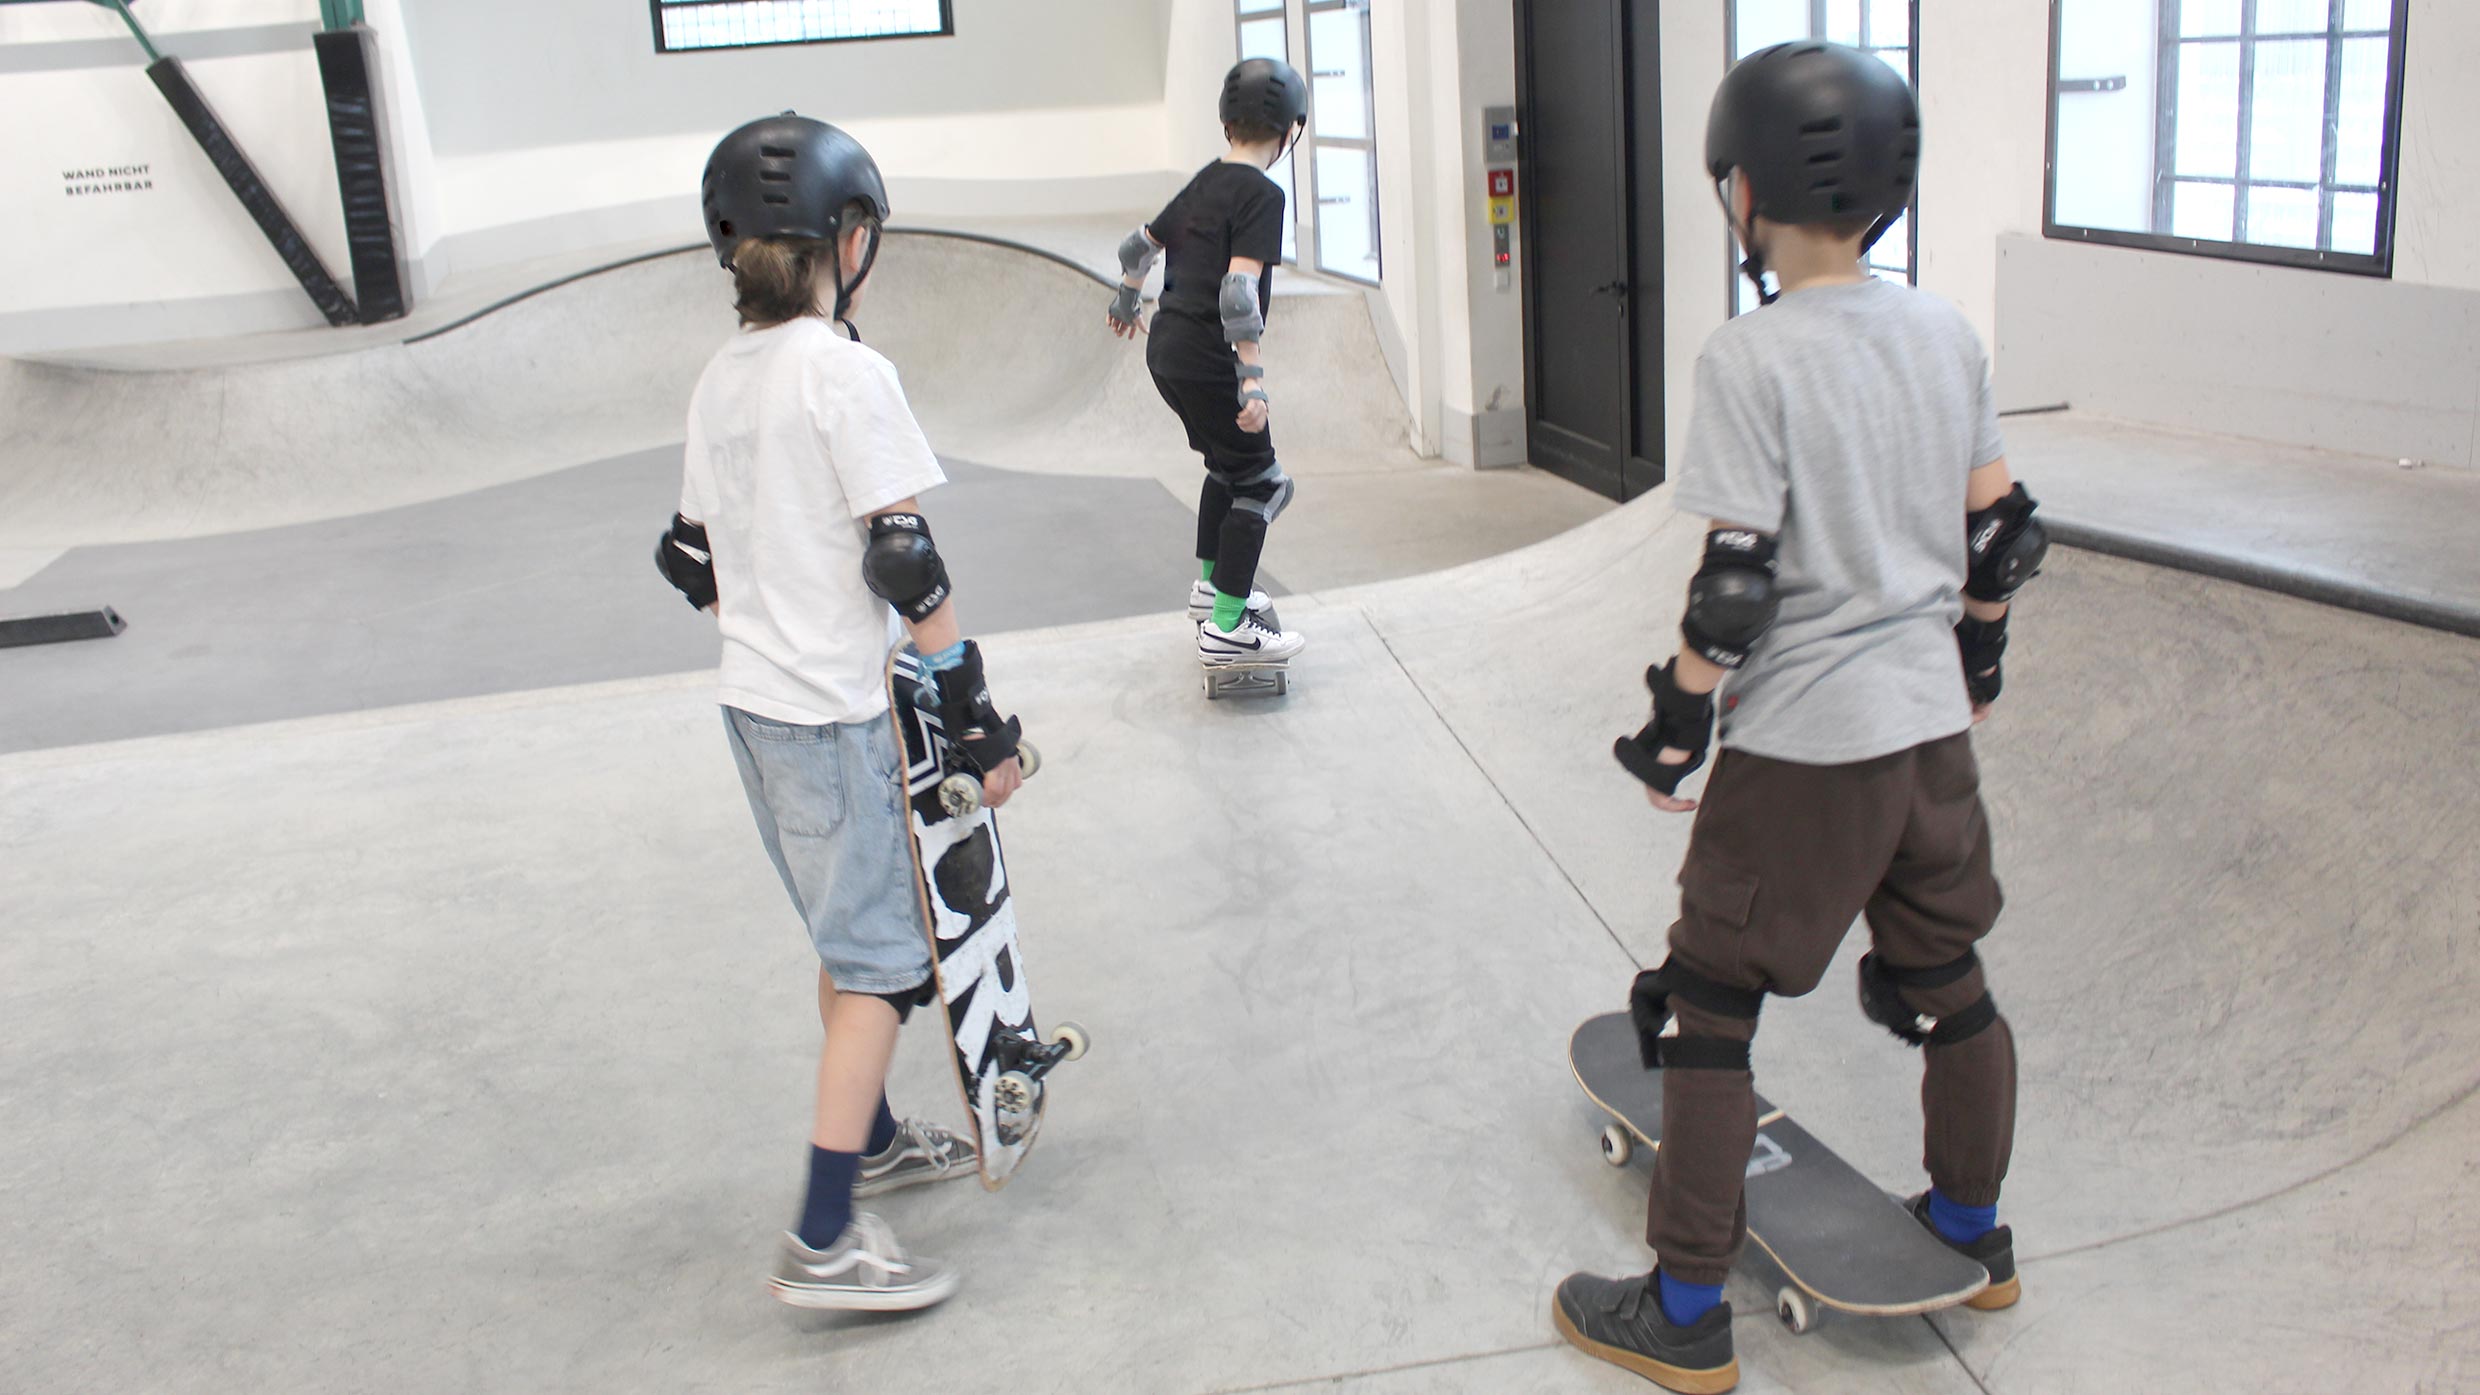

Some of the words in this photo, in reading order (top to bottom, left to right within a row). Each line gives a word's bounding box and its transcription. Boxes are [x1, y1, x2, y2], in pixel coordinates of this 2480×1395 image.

[62, 168, 105, 180] WAND
[108, 164, 149, 176] NICHT
[65, 180, 153, 195] BEFAHRBAR
